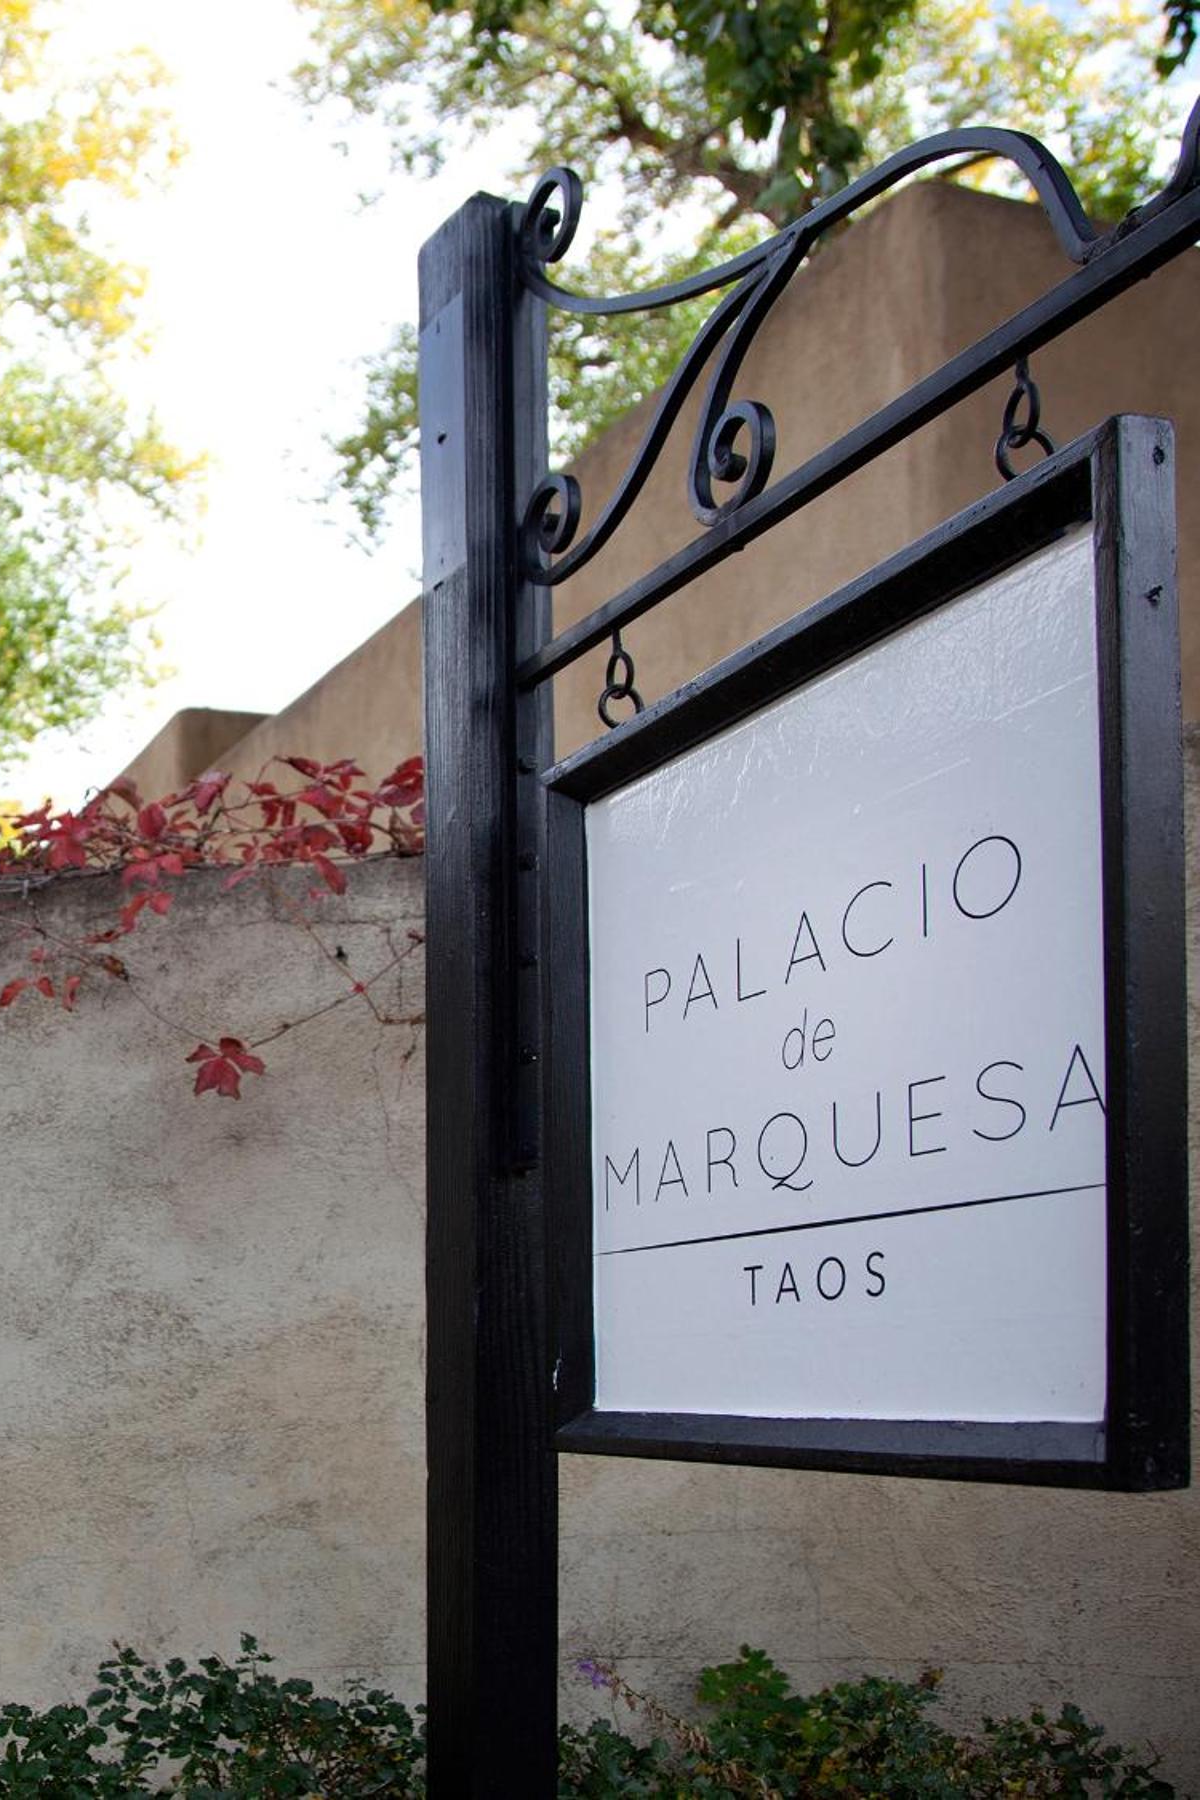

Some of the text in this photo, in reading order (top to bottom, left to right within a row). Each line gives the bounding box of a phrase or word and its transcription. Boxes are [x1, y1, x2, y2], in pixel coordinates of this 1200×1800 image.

[644, 835, 1022, 1033] PALACIO
[781, 1007, 837, 1070] de
[604, 1043, 1107, 1211] MARQUESA
[743, 1251, 886, 1306] TAOS
